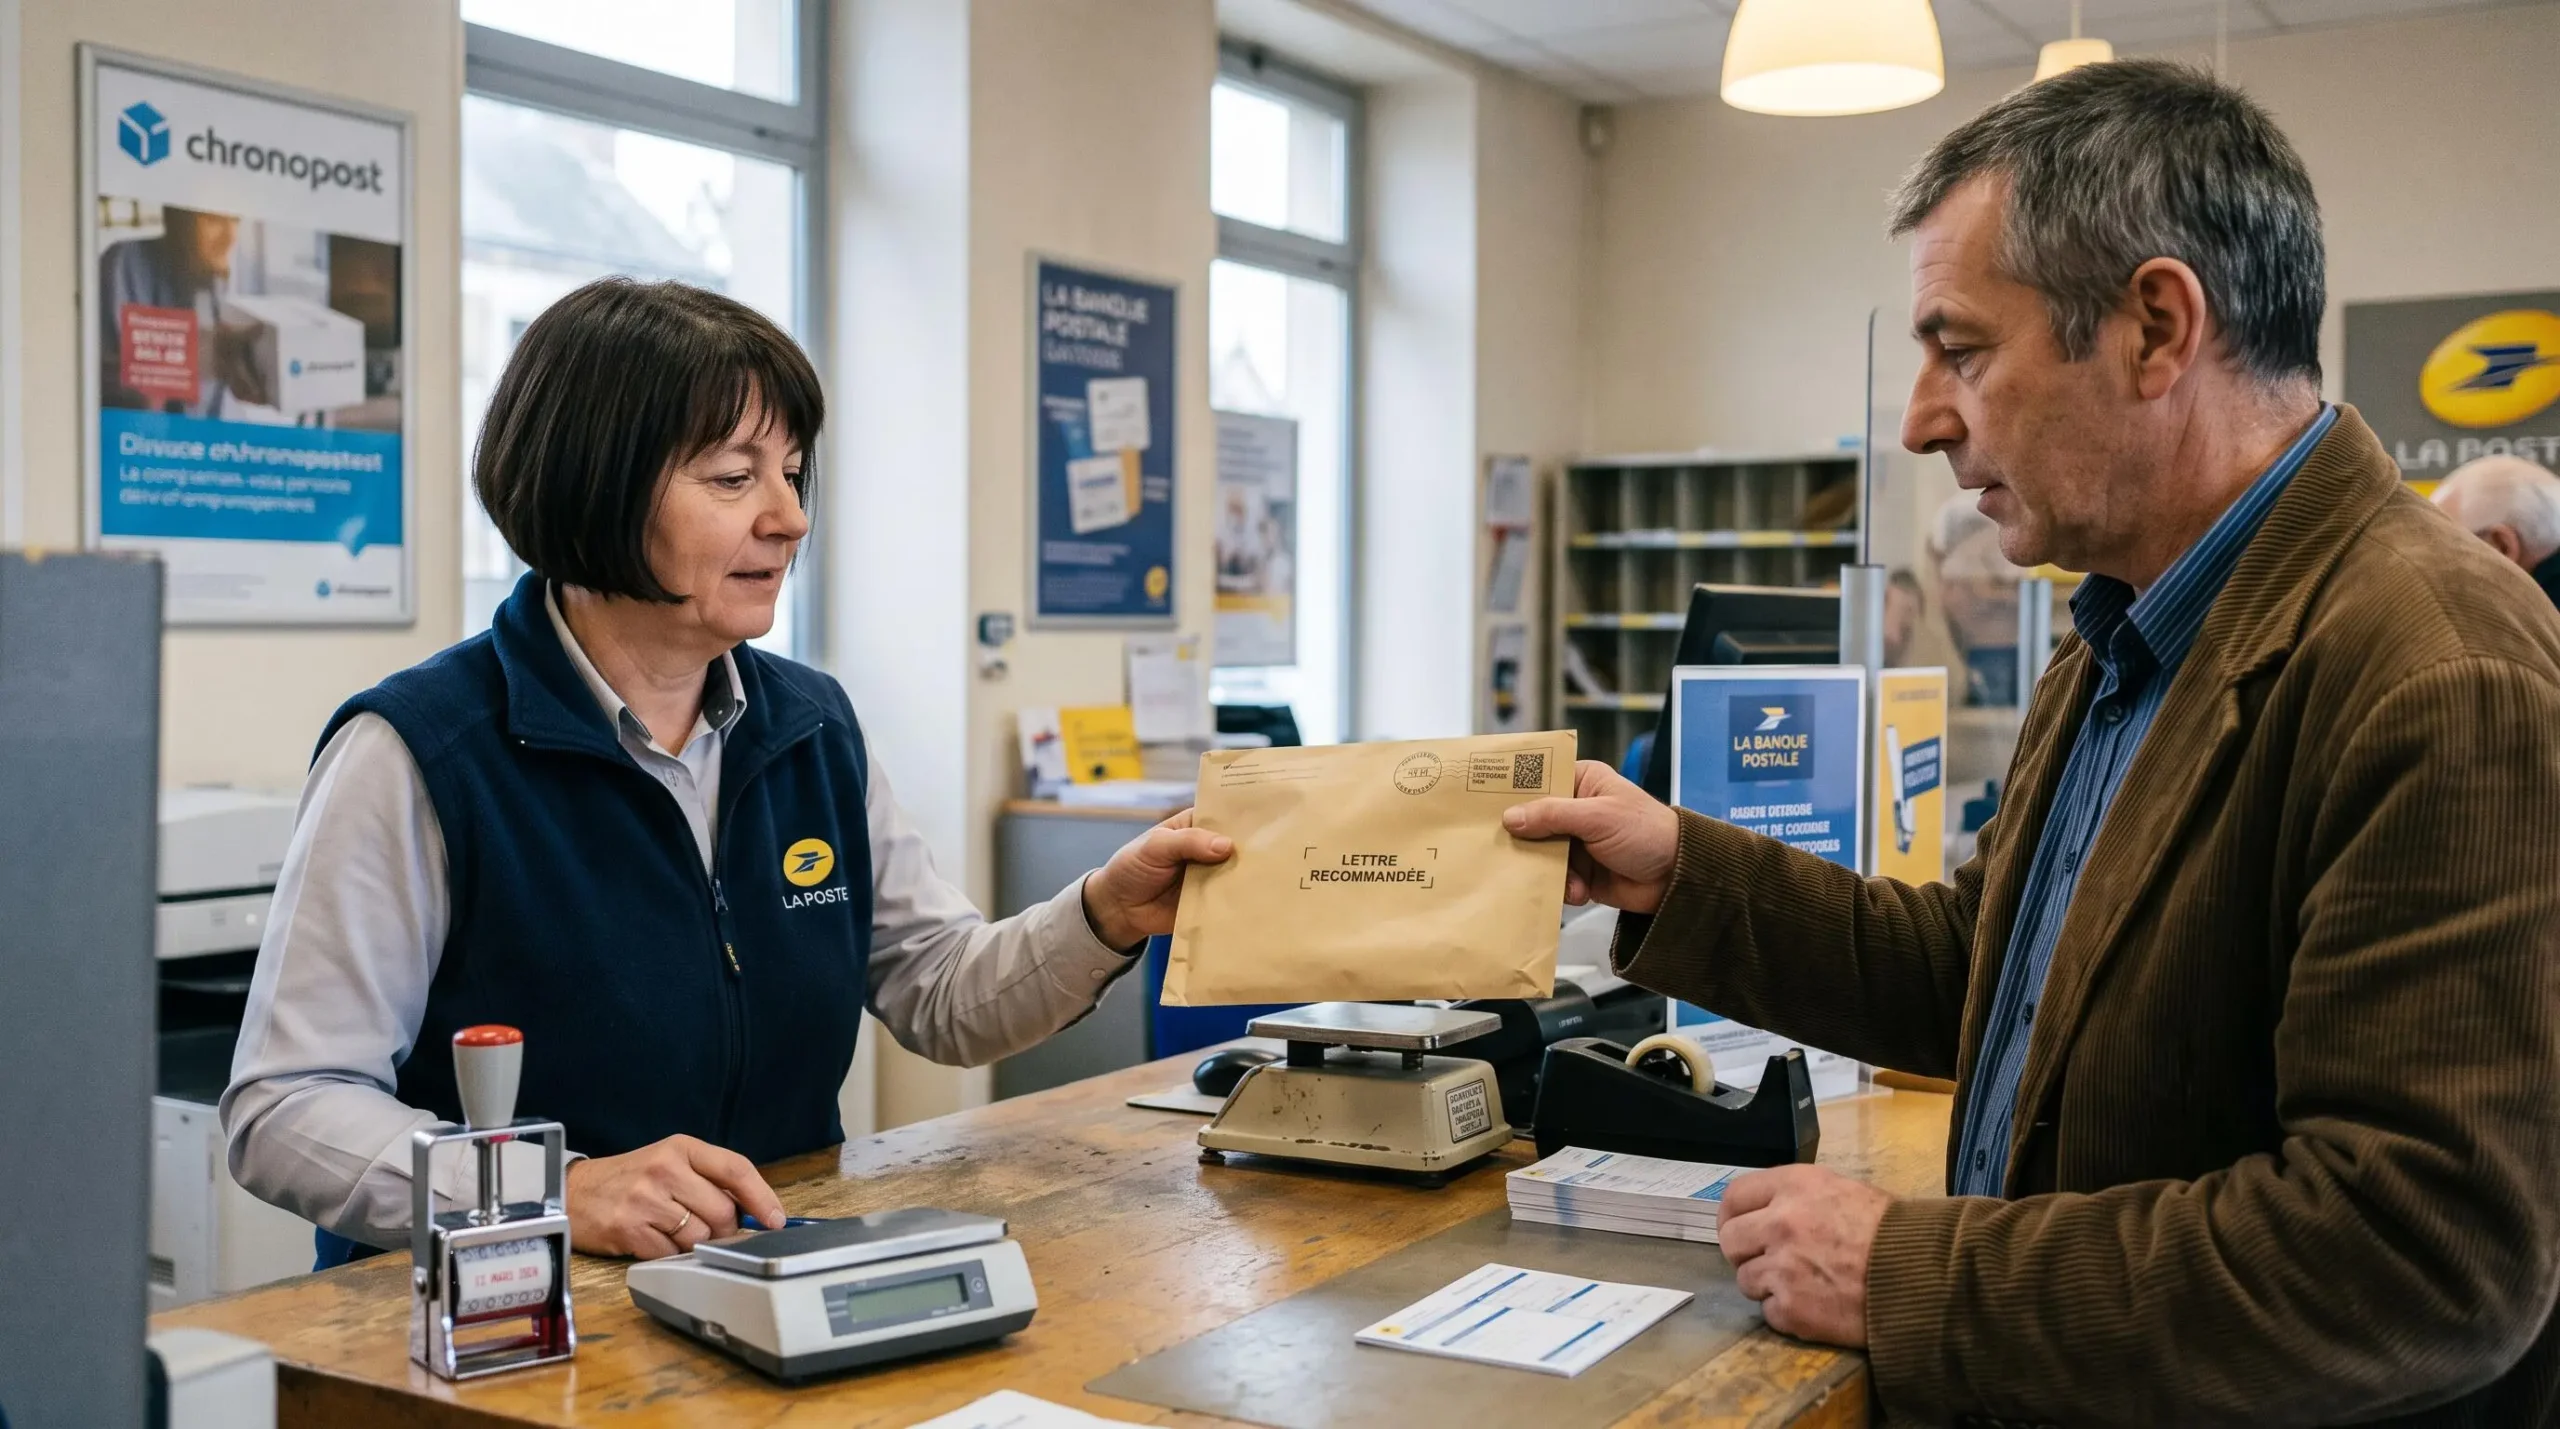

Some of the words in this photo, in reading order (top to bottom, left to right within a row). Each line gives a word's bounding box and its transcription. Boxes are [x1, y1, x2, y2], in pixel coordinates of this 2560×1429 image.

[186, 126, 383, 195] chronopost
[2396, 438, 2448, 470] LA
[1733, 736, 1752, 751] LA
[1754, 734, 1808, 750] BANQUE
[1742, 751, 1799, 768] POSTALE
[1341, 854, 1398, 867] LETTRE
[1310, 867, 1426, 882] RECOMMANDÉE
[782, 894, 804, 909] LA
[804, 887, 849, 906] POSTE
